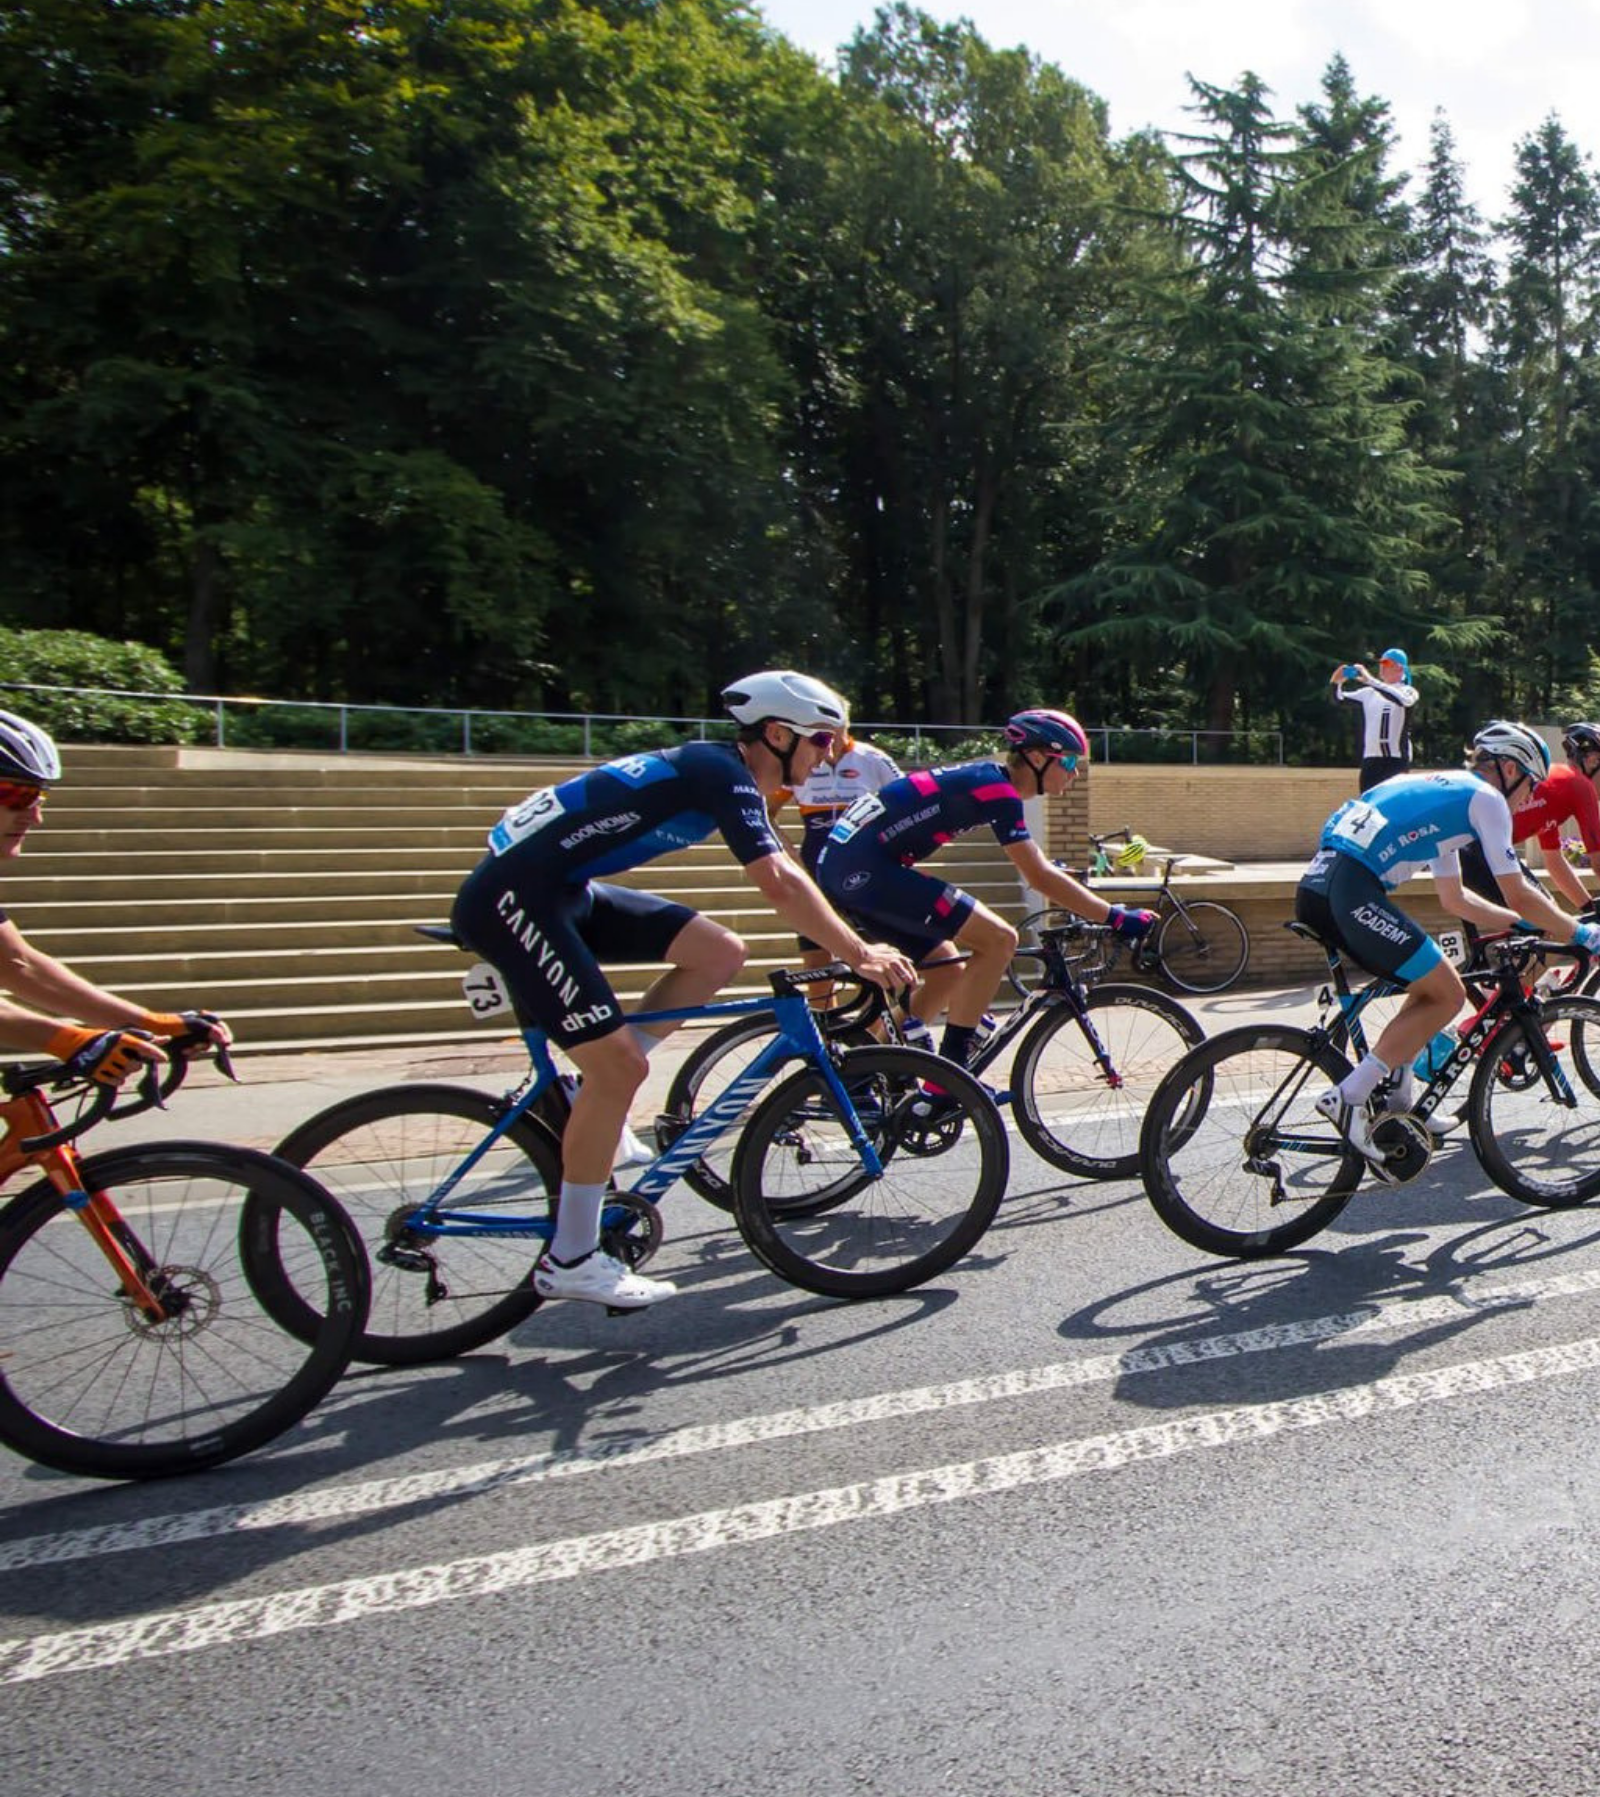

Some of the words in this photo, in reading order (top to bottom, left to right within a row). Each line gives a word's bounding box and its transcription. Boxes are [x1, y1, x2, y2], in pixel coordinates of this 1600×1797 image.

[560, 823, 600, 849] BLOOR
[1350, 810, 1372, 834] 4
[1378, 843, 1397, 863] DE
[1398, 823, 1440, 847] ROSA
[1351, 906, 1411, 945] ACADEMY
[497, 890, 580, 1007] CANYON
[1441, 936, 1459, 958] 85
[466, 976, 502, 1011] 73
[1318, 986, 1334, 1006] 4
[561, 1004, 613, 1032] dhb
[1422, 1081, 1448, 1112] DE
[1445, 1018, 1497, 1080] ROSA
[638, 1077, 775, 1194] CANYON
[309, 1211, 341, 1273] BLACK
[332, 1281, 352, 1312] INC
